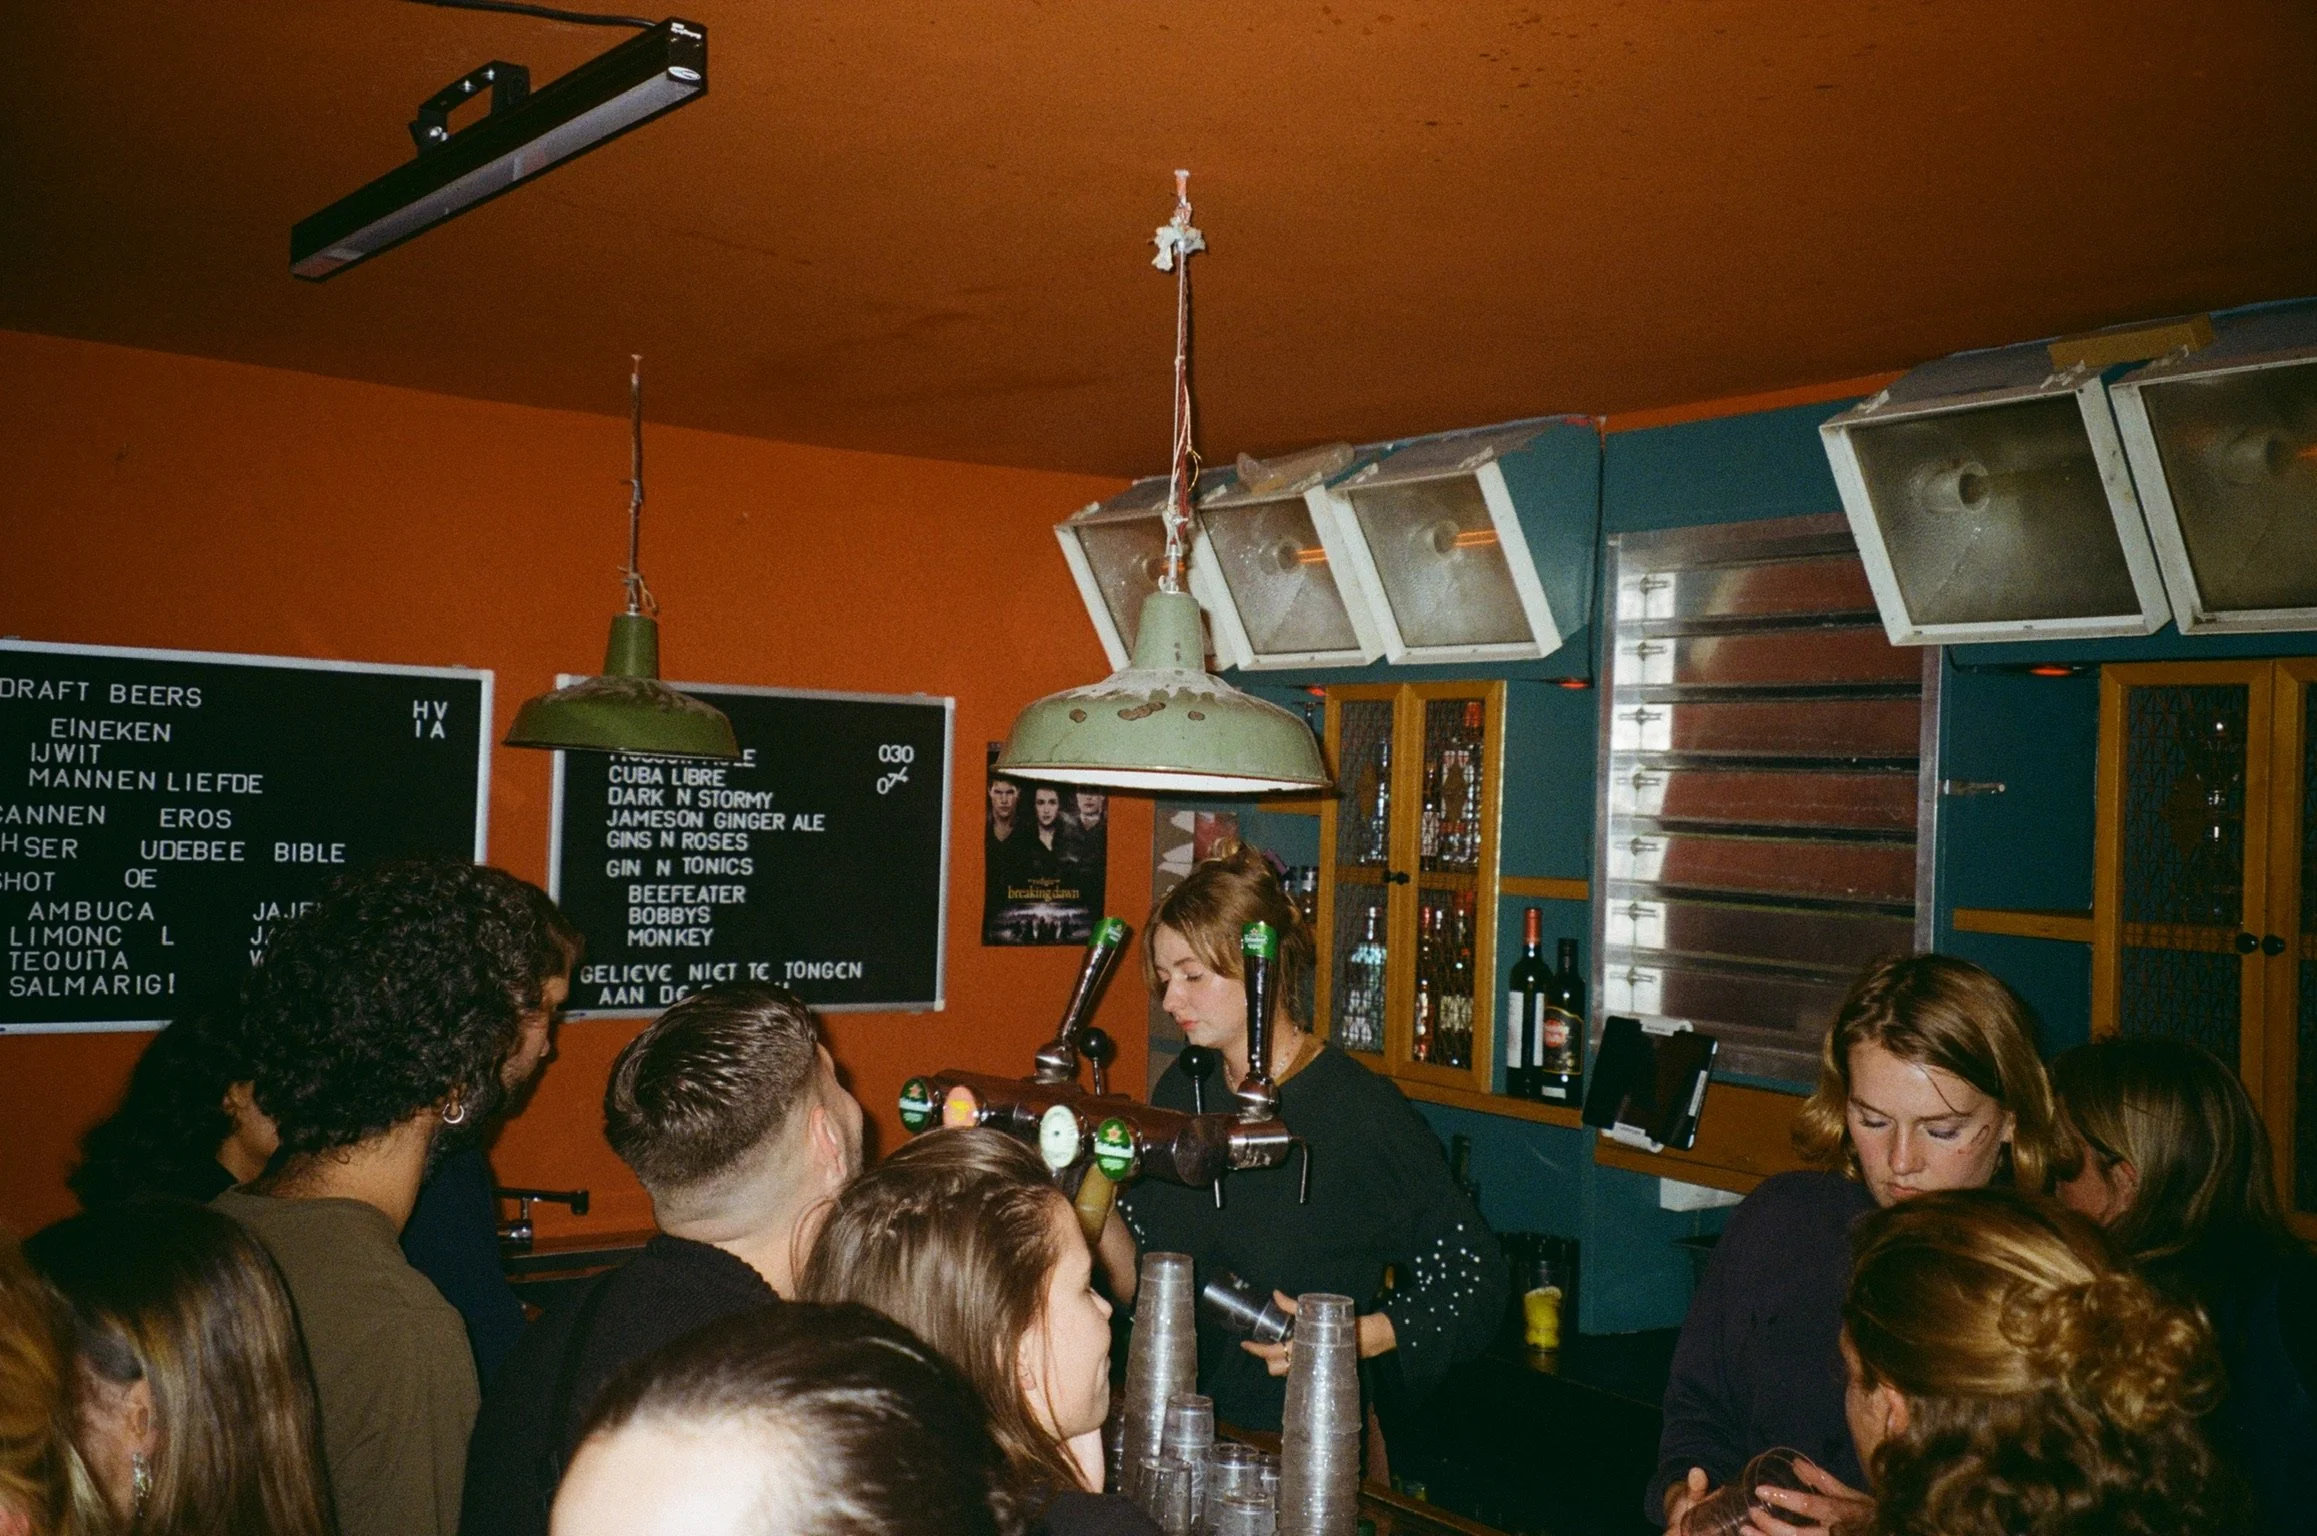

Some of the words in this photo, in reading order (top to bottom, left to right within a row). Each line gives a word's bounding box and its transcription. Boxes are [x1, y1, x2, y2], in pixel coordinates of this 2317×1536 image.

[0, 677, 90, 701] DRAFT
[109, 683, 202, 708] BEERS
[50, 717, 171, 743] EINEKEN
[28, 767, 156, 791] MANNEN
[166, 771, 264, 794] LIEFDE
[608, 764, 664, 785] CUBA
[671, 766, 727, 788] LIBRE
[607, 786, 665, 807] DARK
[676, 787, 692, 806] N
[697, 788, 774, 810] STORMY
[159, 807, 232, 830] EROS
[606, 808, 704, 829] JAMESON
[713, 811, 786, 831] GINGER
[791, 813, 826, 832] ALE
[140, 839, 246, 862] UDEBEE
[274, 841, 346, 863] BIBLE
[606, 829, 653, 850] GINS
[660, 830, 675, 848] N
[681, 831, 749, 852] ROSES
[605, 858, 642, 878] GIN
[655, 859, 671, 877] N
[681, 855, 754, 876] TONICS
[628, 884, 746, 904] BEEFEATER
[1007, 885, 1052, 901] breaking
[1052, 885, 1080, 899] dawn
[27, 900, 155, 922] AMBUCA
[628, 905, 711, 926] BOBBYS
[10, 925, 122, 947] LIMONC
[627, 927, 714, 948] MONKEY
[598, 985, 645, 1006] AAN
